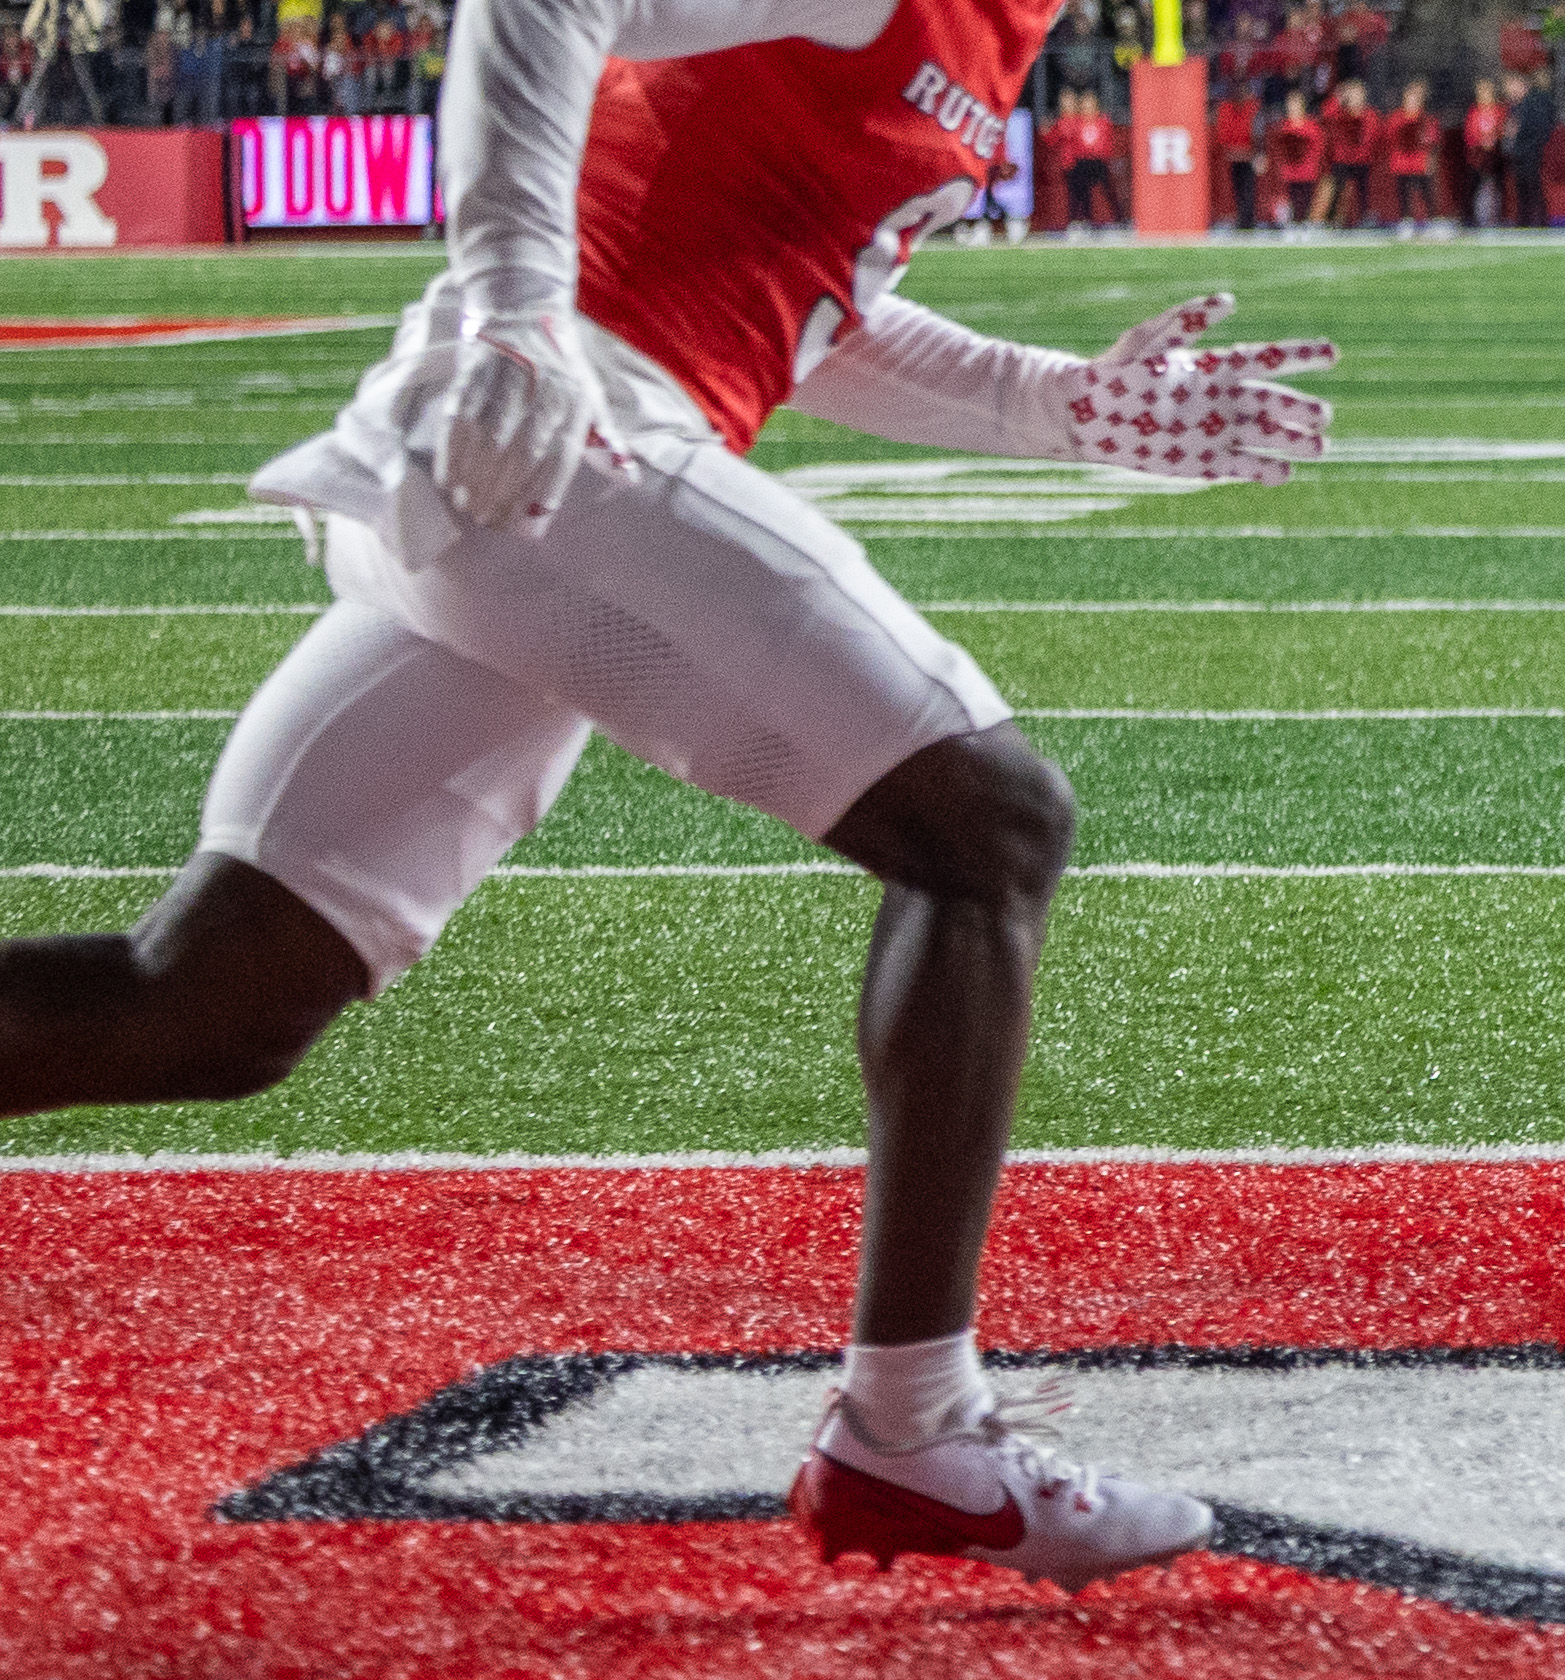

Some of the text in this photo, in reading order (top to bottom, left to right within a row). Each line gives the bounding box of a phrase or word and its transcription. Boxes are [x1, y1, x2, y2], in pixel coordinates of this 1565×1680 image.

[901, 60, 1007, 160] RUTG
[1147, 125, 1194, 176] R
[0, 130, 118, 248] R
[285, 115, 444, 223] DOW
